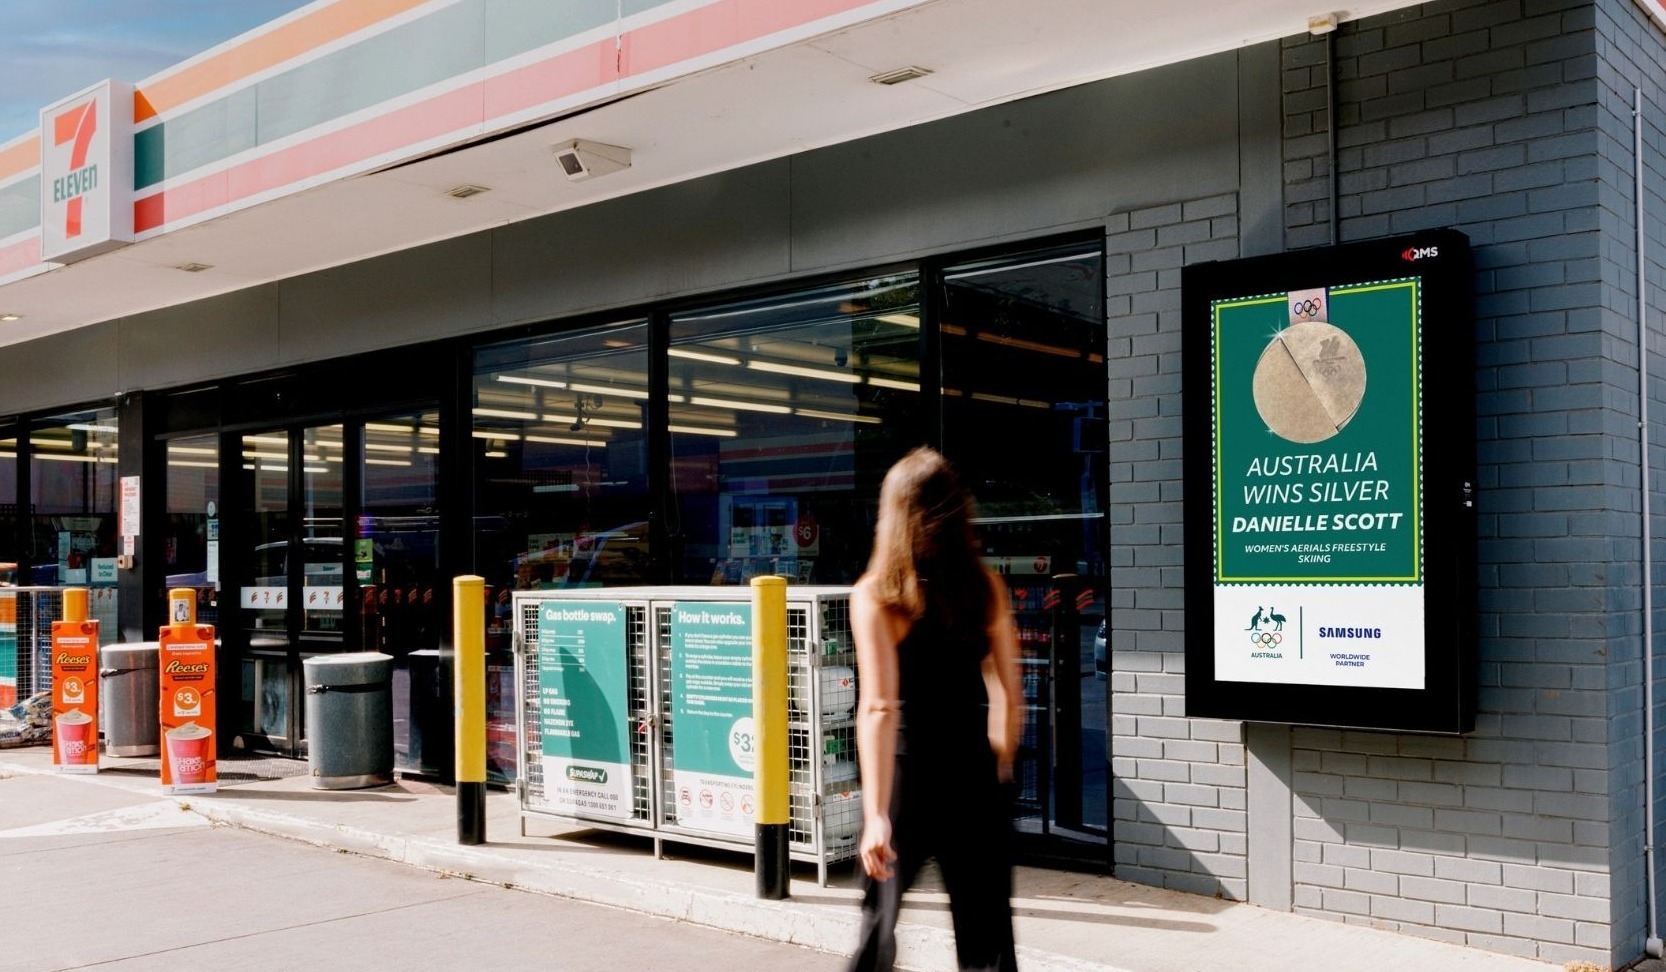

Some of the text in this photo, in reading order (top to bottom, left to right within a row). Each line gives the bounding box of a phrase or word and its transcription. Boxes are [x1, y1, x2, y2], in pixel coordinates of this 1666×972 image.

[1407, 246, 1439, 262] QMS
[1246, 451, 1378, 477] AUSTRALIA
[1243, 480, 1390, 505] WINS SILVER
[1232, 512, 1403, 533] DANIELLE SCOTT
[1244, 542, 1386, 553] WOMEN'S AERIALS FREESTYLE
[1298, 554, 1331, 563] SKIING
[545, 609, 617, 625] Gas bottle swap.
[678, 610, 746, 625] How it works.
[1319, 626, 1382, 639] SAMSUNG
[1329, 653, 1371, 661] WORLDWIDE
